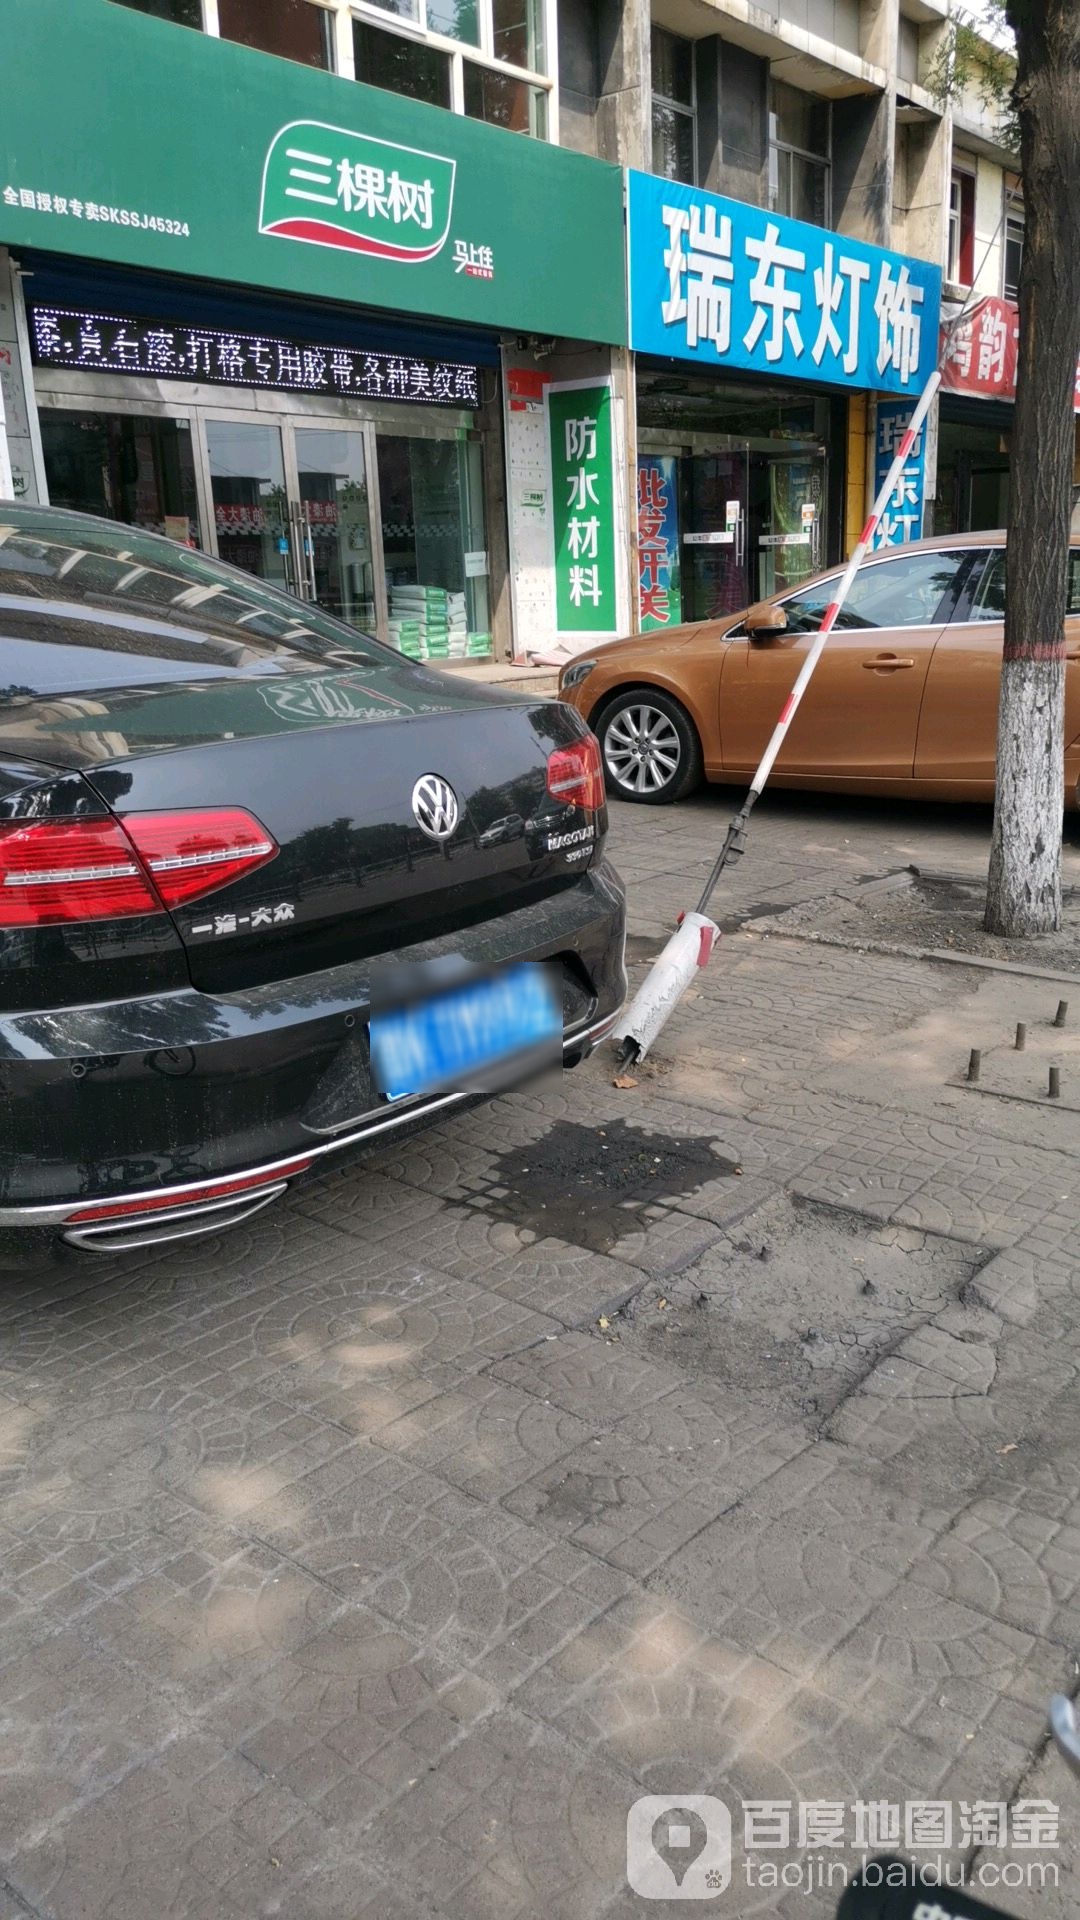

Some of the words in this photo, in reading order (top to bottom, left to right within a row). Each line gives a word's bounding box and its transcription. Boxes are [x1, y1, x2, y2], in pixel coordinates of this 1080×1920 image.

[2, 185, 190, 238] 全国授权专卖SKSSJ45324
[285, 148, 435, 230] 三棵树
[661, 203, 925, 384] 瑞东灯饰
[565, 415, 603, 607] 防水材料
[638, 467, 671, 623] 批发开关
